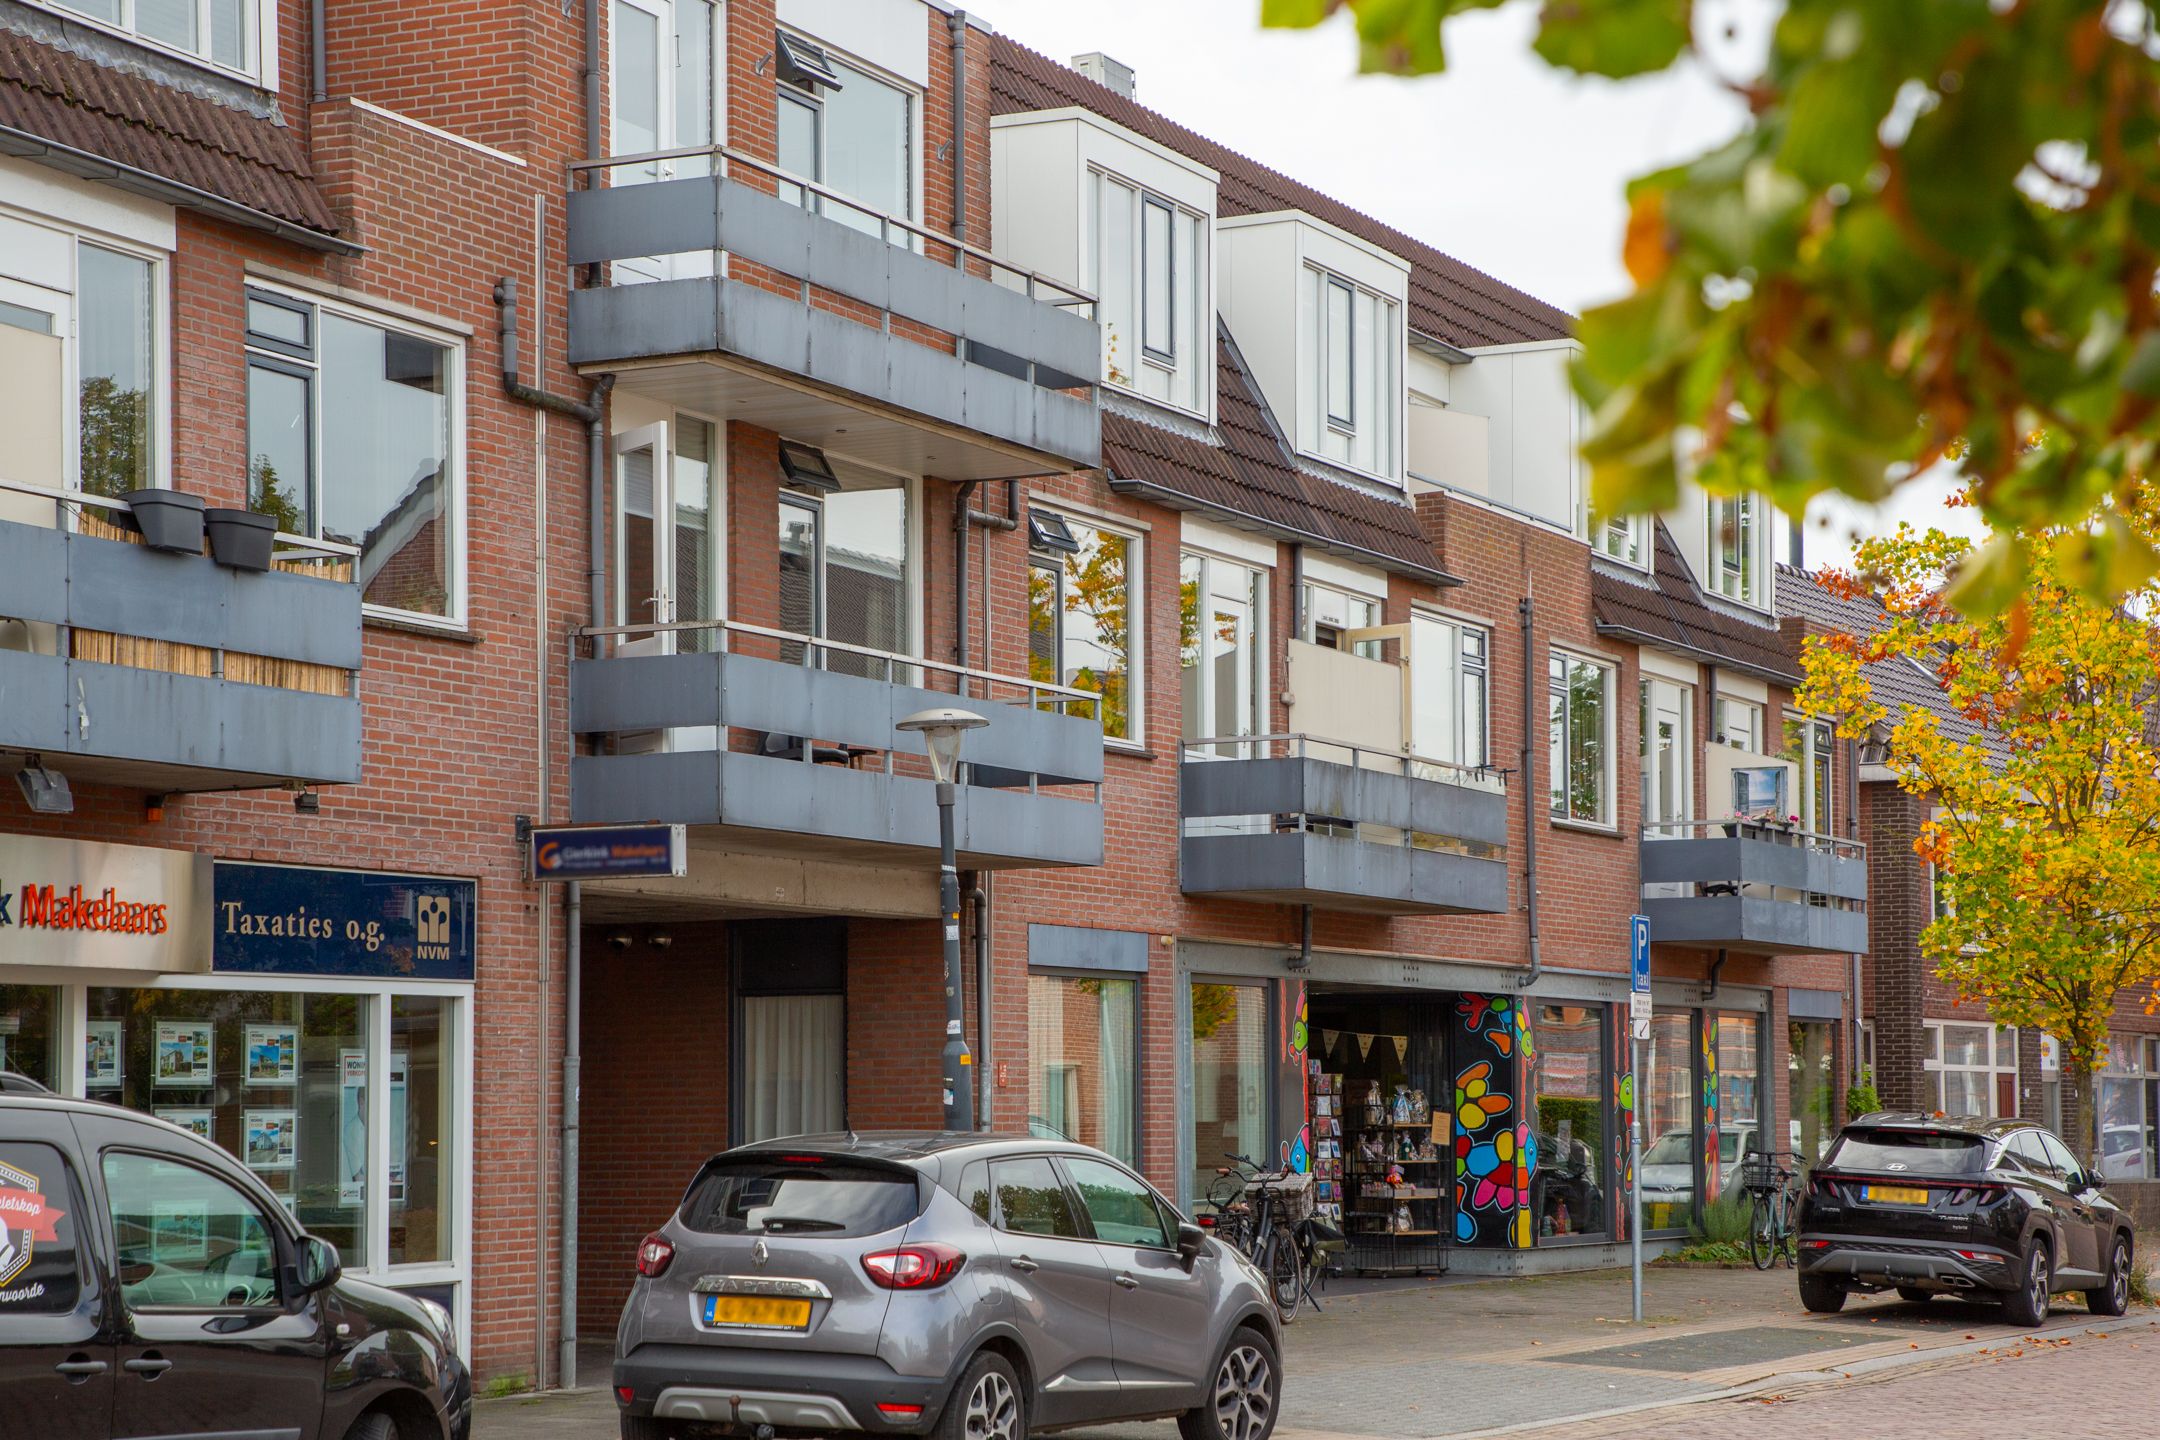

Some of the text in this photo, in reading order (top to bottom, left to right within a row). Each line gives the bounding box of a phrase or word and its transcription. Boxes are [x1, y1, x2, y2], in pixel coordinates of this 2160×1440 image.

[20, 883, 168, 935] Makelaars
[221, 901, 386, 951] Taxaties o.g.
[417, 945, 450, 961] NVM
[1638, 923, 1647, 960] P
[1637, 971, 1648, 986] taxi
